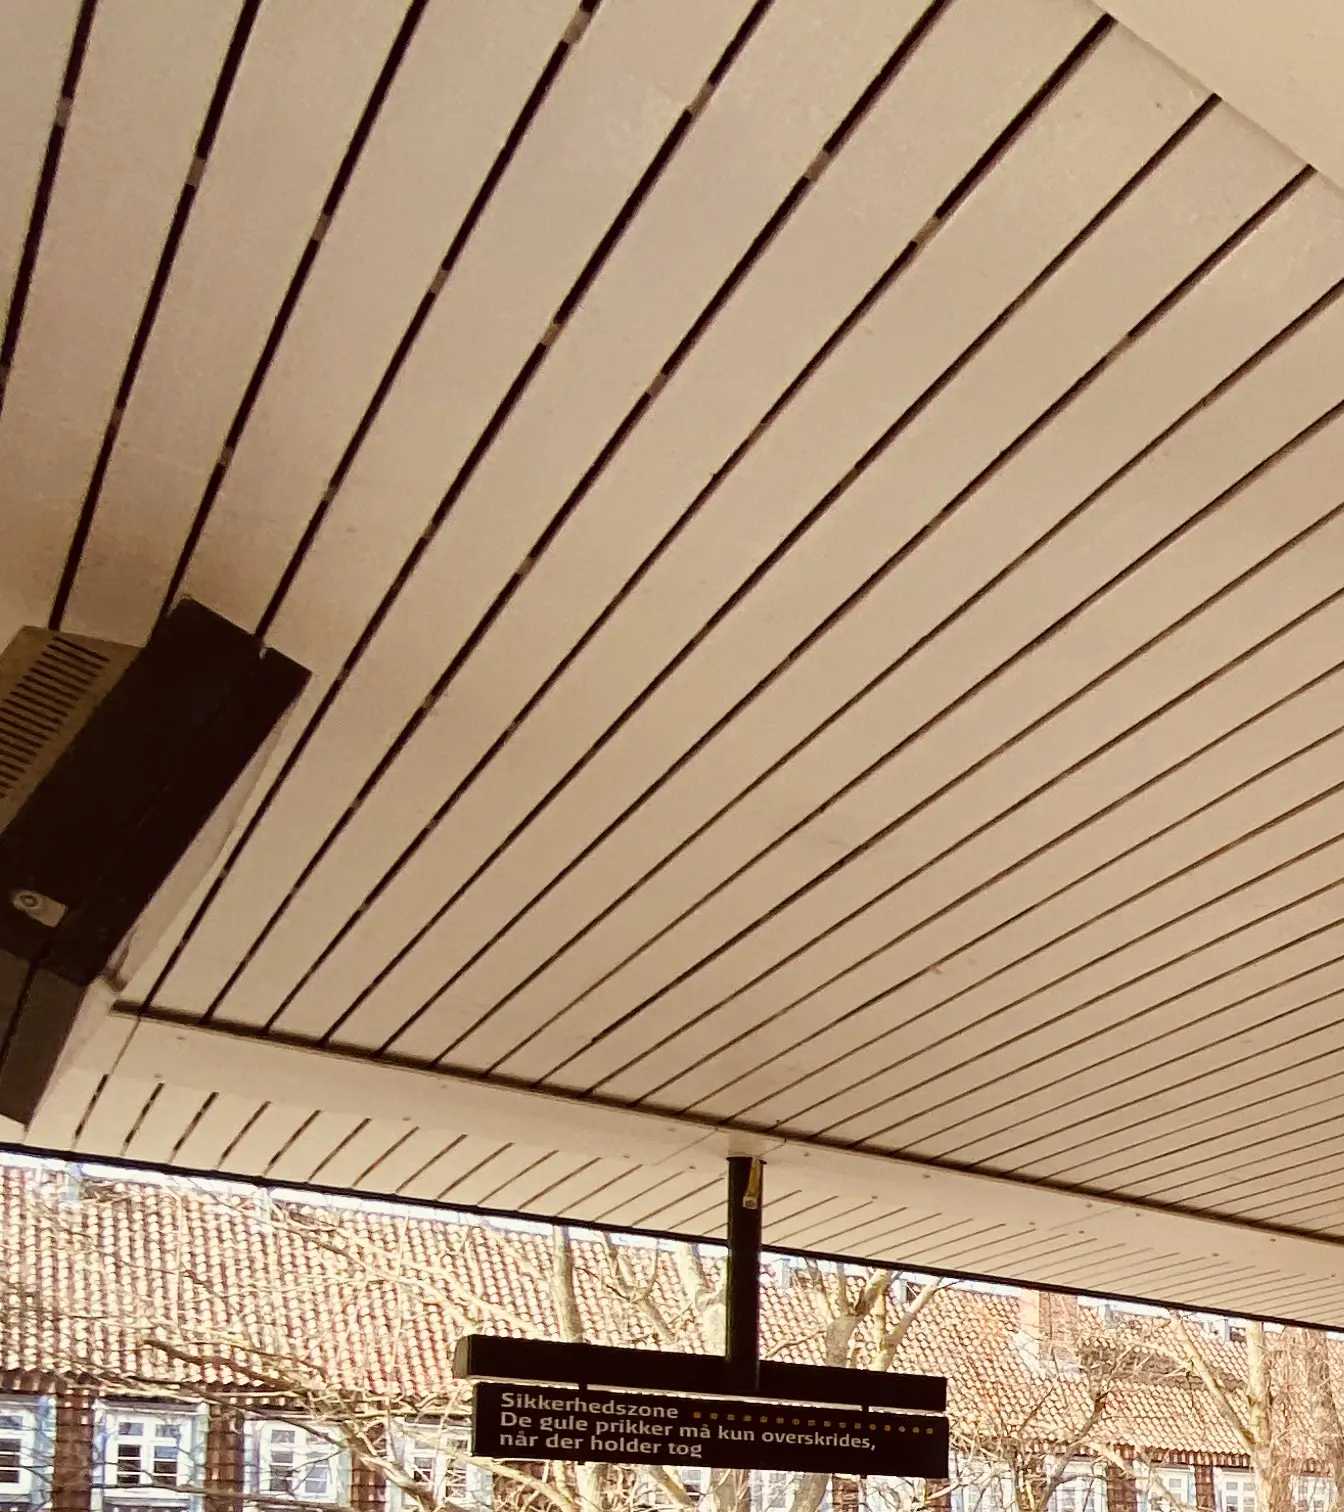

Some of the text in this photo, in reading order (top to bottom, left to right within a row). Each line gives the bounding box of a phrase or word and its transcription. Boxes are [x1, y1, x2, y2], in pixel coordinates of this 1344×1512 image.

[500, 1392, 679, 1419] Sikkerhedszone
[499, 1430, 703, 1459] når der holder tog
[500, 1411, 876, 1452] De gule prikker må kun overskrides,
